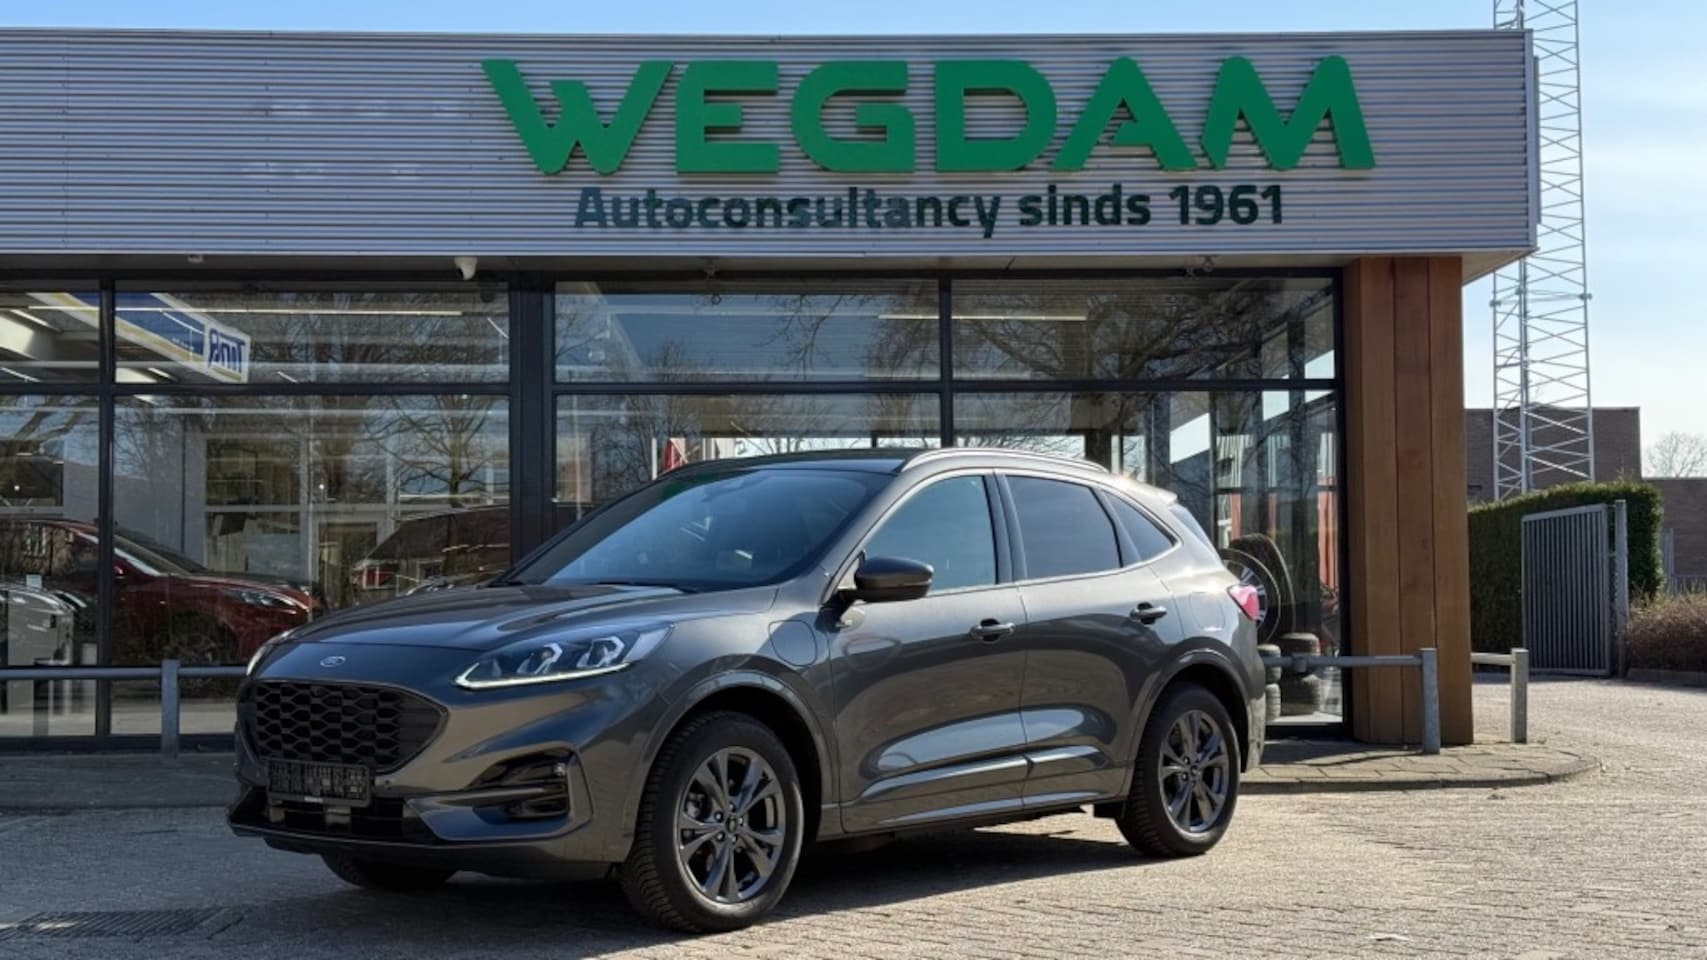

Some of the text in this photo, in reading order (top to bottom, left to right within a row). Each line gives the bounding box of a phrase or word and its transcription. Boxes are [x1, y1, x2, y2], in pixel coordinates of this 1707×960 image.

[480, 55, 1376, 175] WEGDAM
[575, 184, 1282, 238] Autoconsultancy sinds 1961
